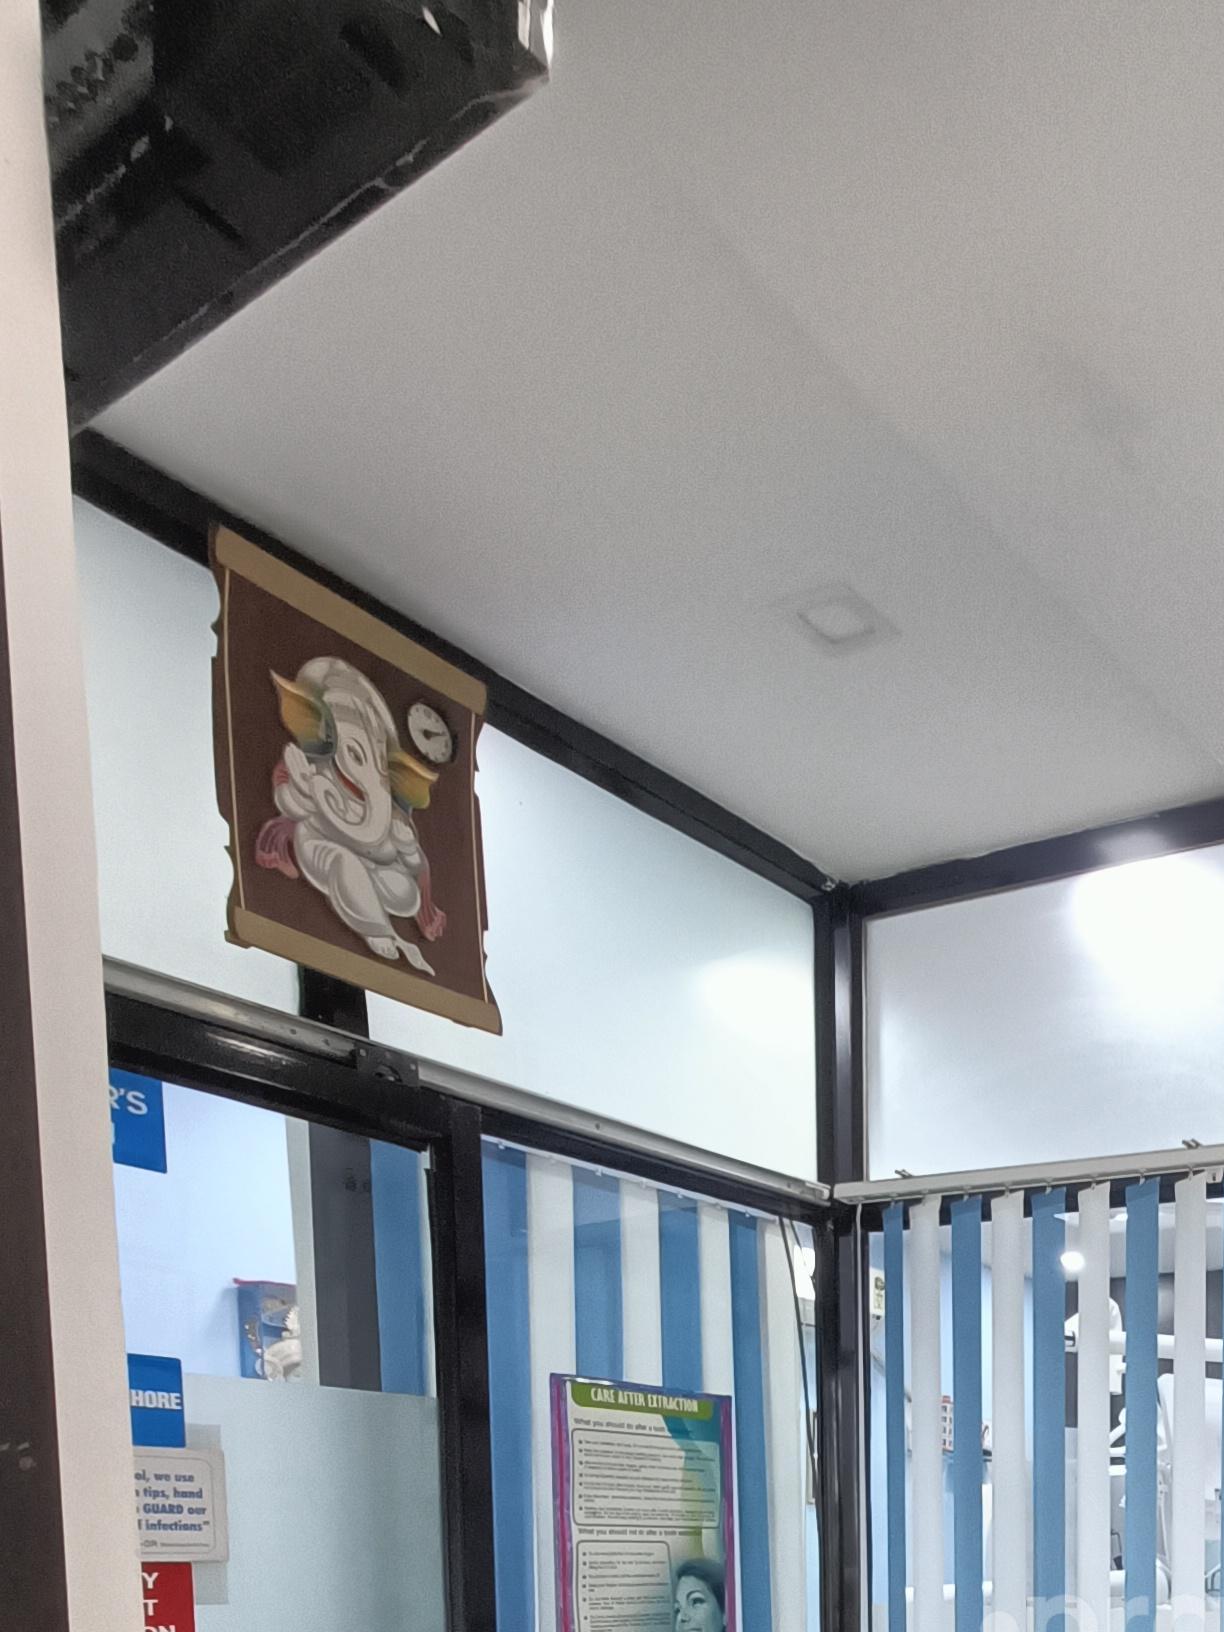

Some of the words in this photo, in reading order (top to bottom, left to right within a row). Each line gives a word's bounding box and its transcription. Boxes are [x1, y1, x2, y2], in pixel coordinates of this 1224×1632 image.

[591, 1387, 615, 1403] CARE
[618, 1391, 646, 1408] AFTER
[648, 1394, 699, 1413] EXTRACTION
[154, 1472, 171, 1482] we
[174, 1473, 195, 1483] use
[173, 1486, 204, 1500] hand
[143, 1503, 183, 1515] GUARD
[142, 1572, 159, 1589] Y
[143, 1599, 158, 1616] T
